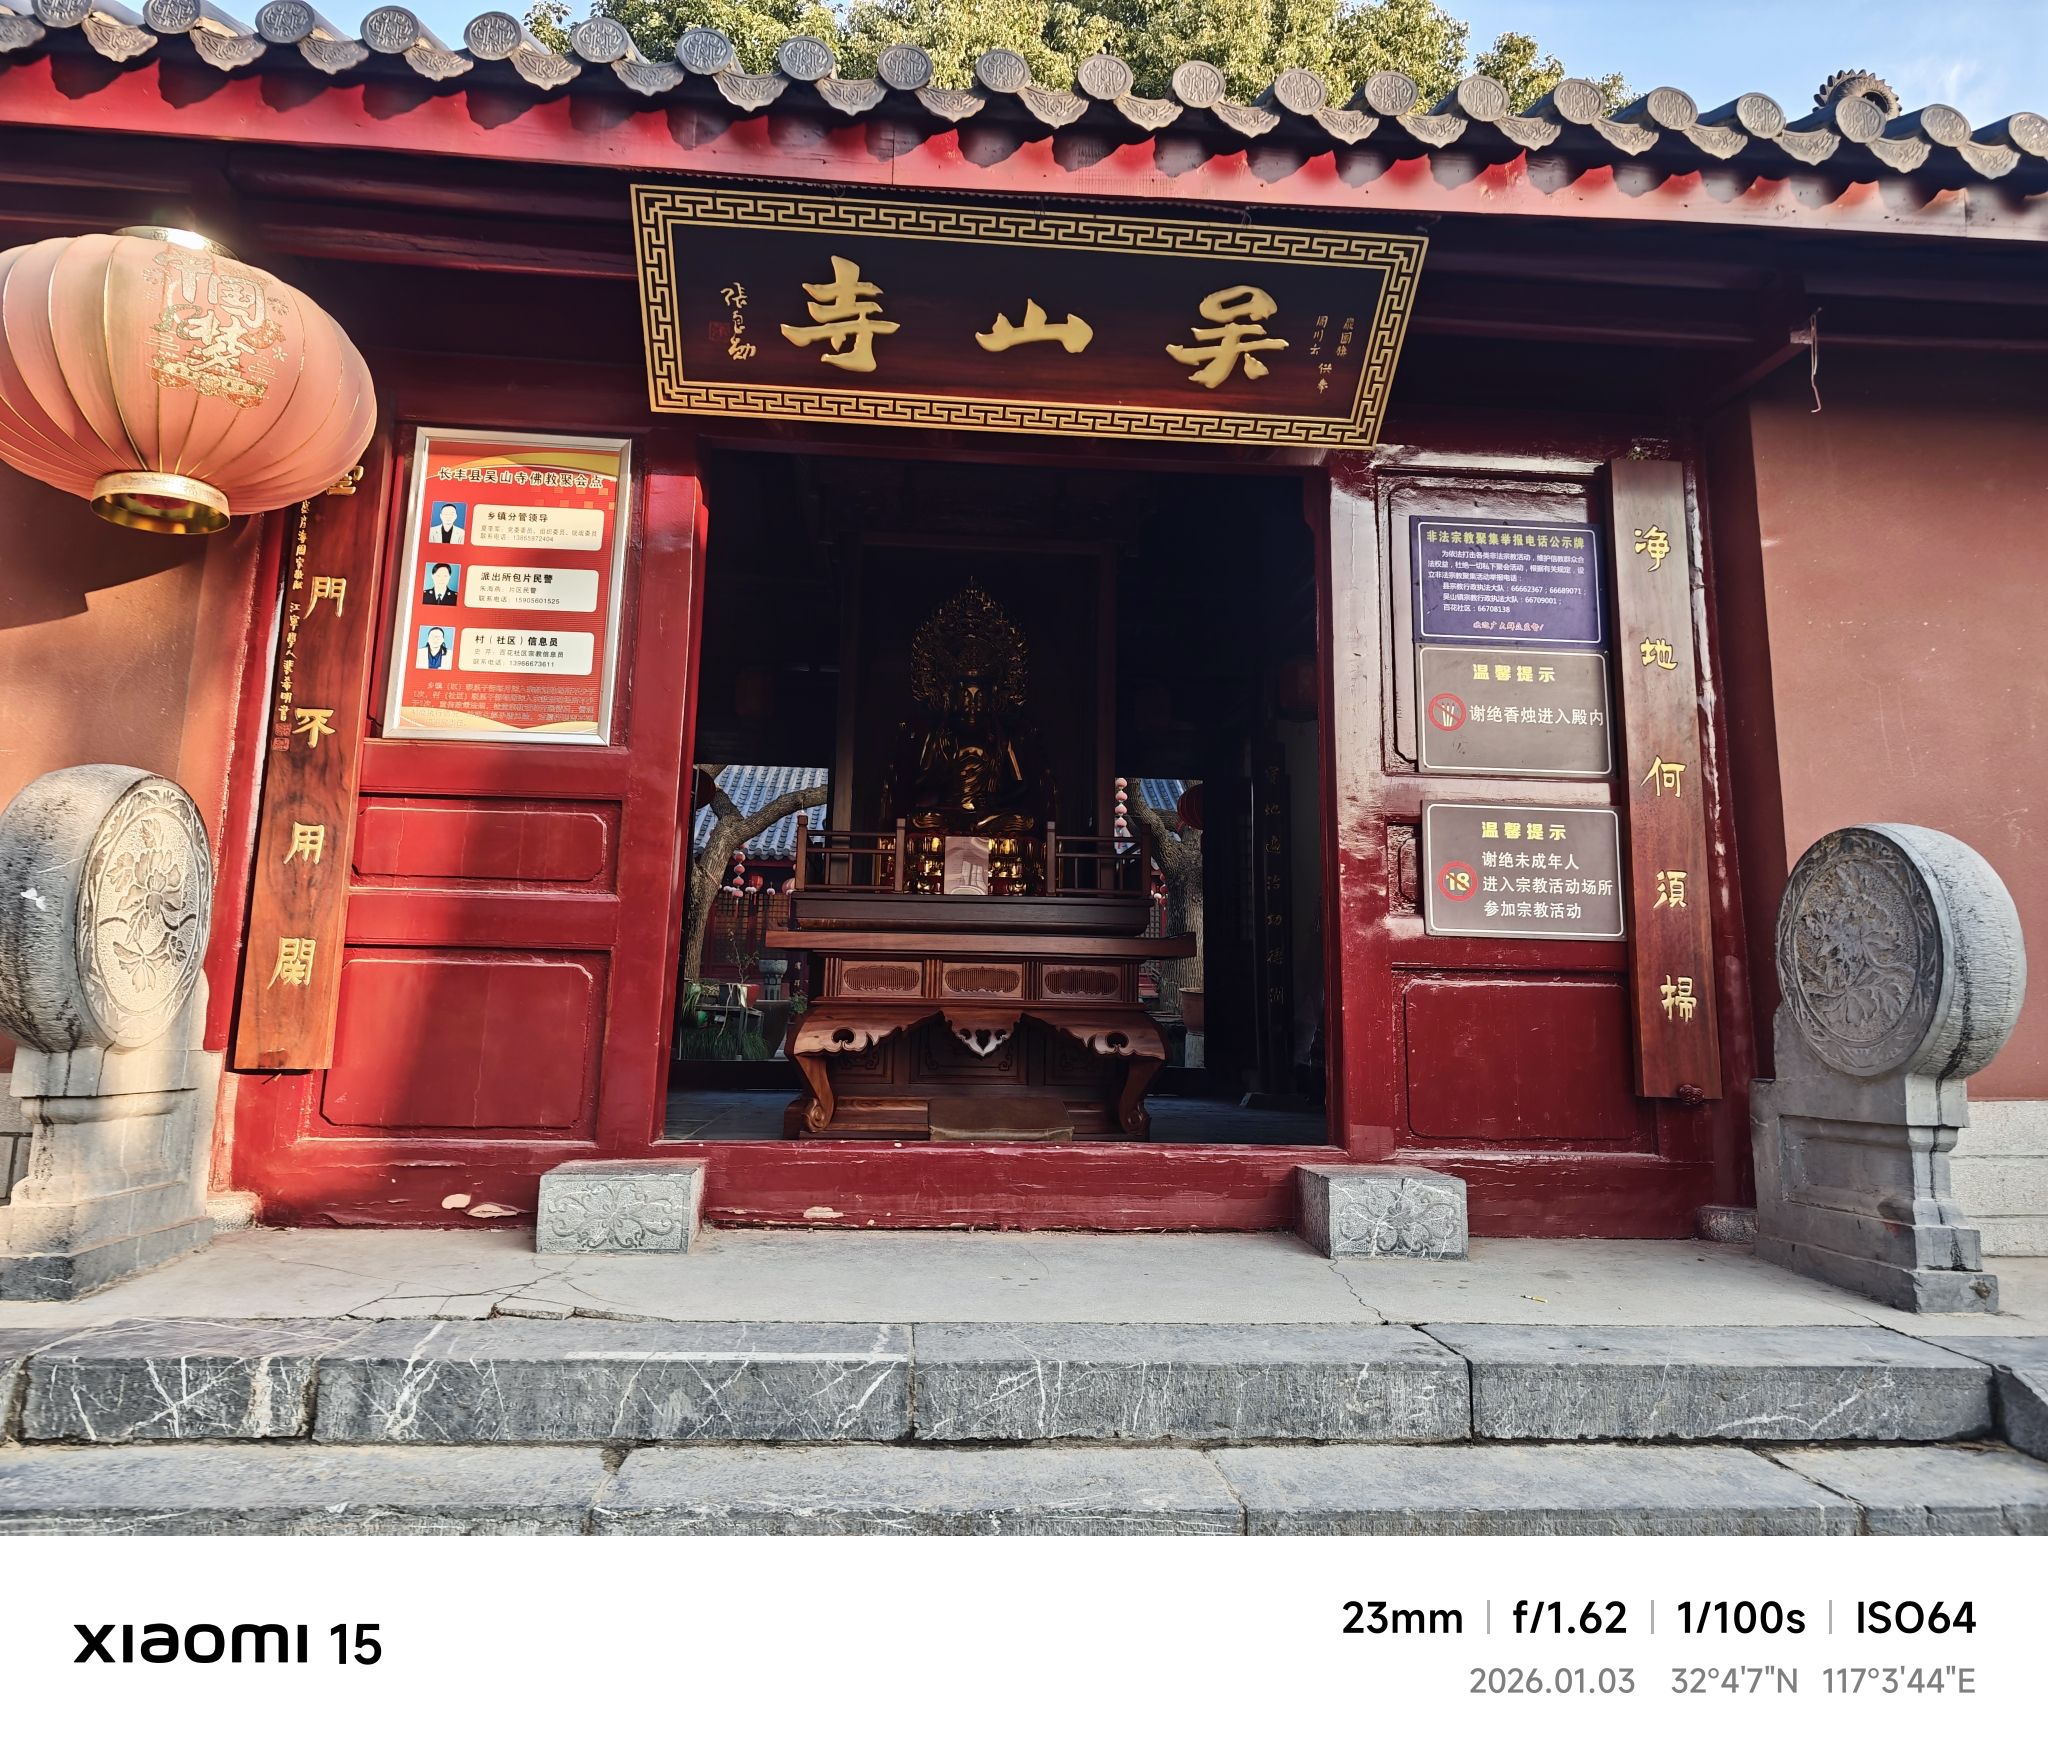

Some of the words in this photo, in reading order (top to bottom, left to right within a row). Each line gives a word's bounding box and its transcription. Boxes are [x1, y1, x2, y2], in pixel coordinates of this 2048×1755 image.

[487, 511, 549, 523] 乡镇分管领导
[1427, 530, 1585, 549] 非法宗教聚集举报电话公示牌
[481, 572, 553, 584] 派出所包片民警
[1472, 663, 1556, 682] 温馨提示
[1469, 704, 1604, 726] 谢绝香烛进入殿内
[1481, 821, 1567, 841] 温馨提示
[1482, 851, 1579, 870] 谢绝未成年人
[1483, 876, 1613, 896] 进入宗教活动场所
[1484, 900, 1581, 919] 参加宗教活动
